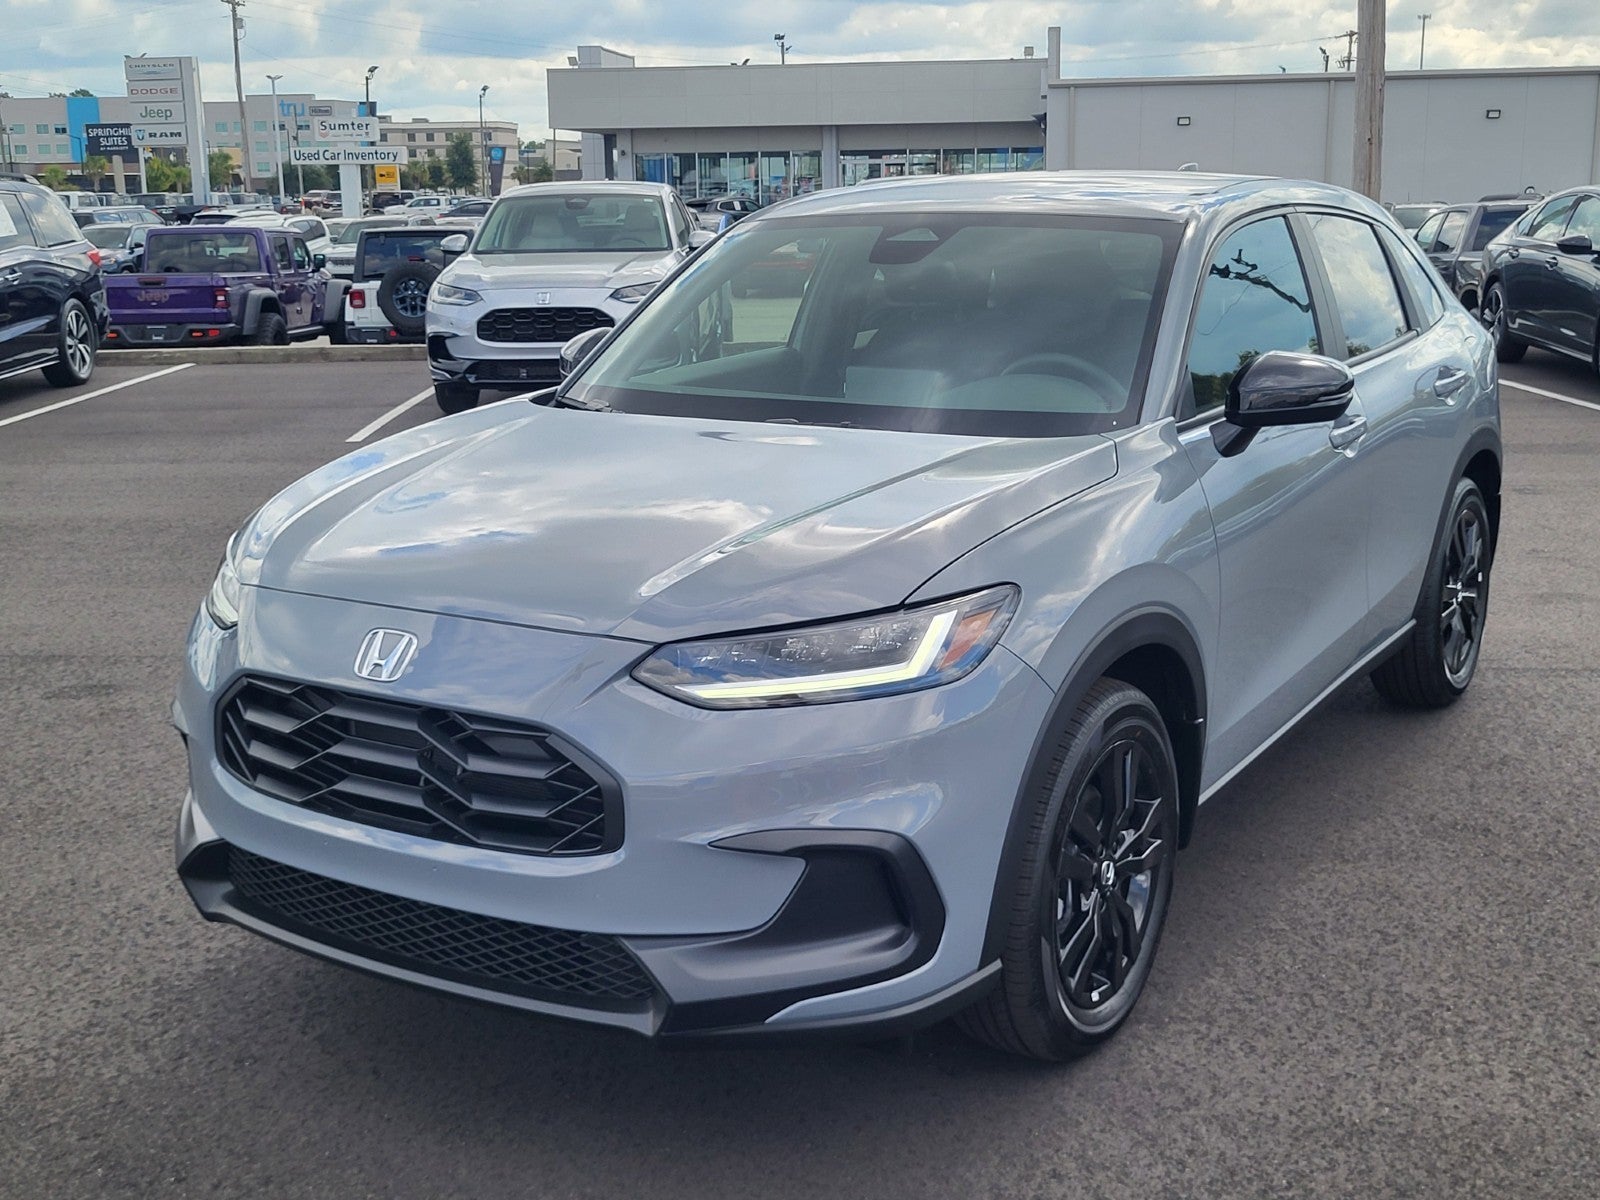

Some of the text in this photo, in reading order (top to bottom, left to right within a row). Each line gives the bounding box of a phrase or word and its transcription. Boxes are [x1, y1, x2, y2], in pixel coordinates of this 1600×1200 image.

[140, 106, 172, 120] Jeep
[319, 120, 370, 131] Sumter
[88, 127, 132, 137] SPRINGHIL
[100, 137, 128, 145] SUITES
[293, 149, 399, 162] Used Car Inventory
[137, 289, 169, 303] Jeep
